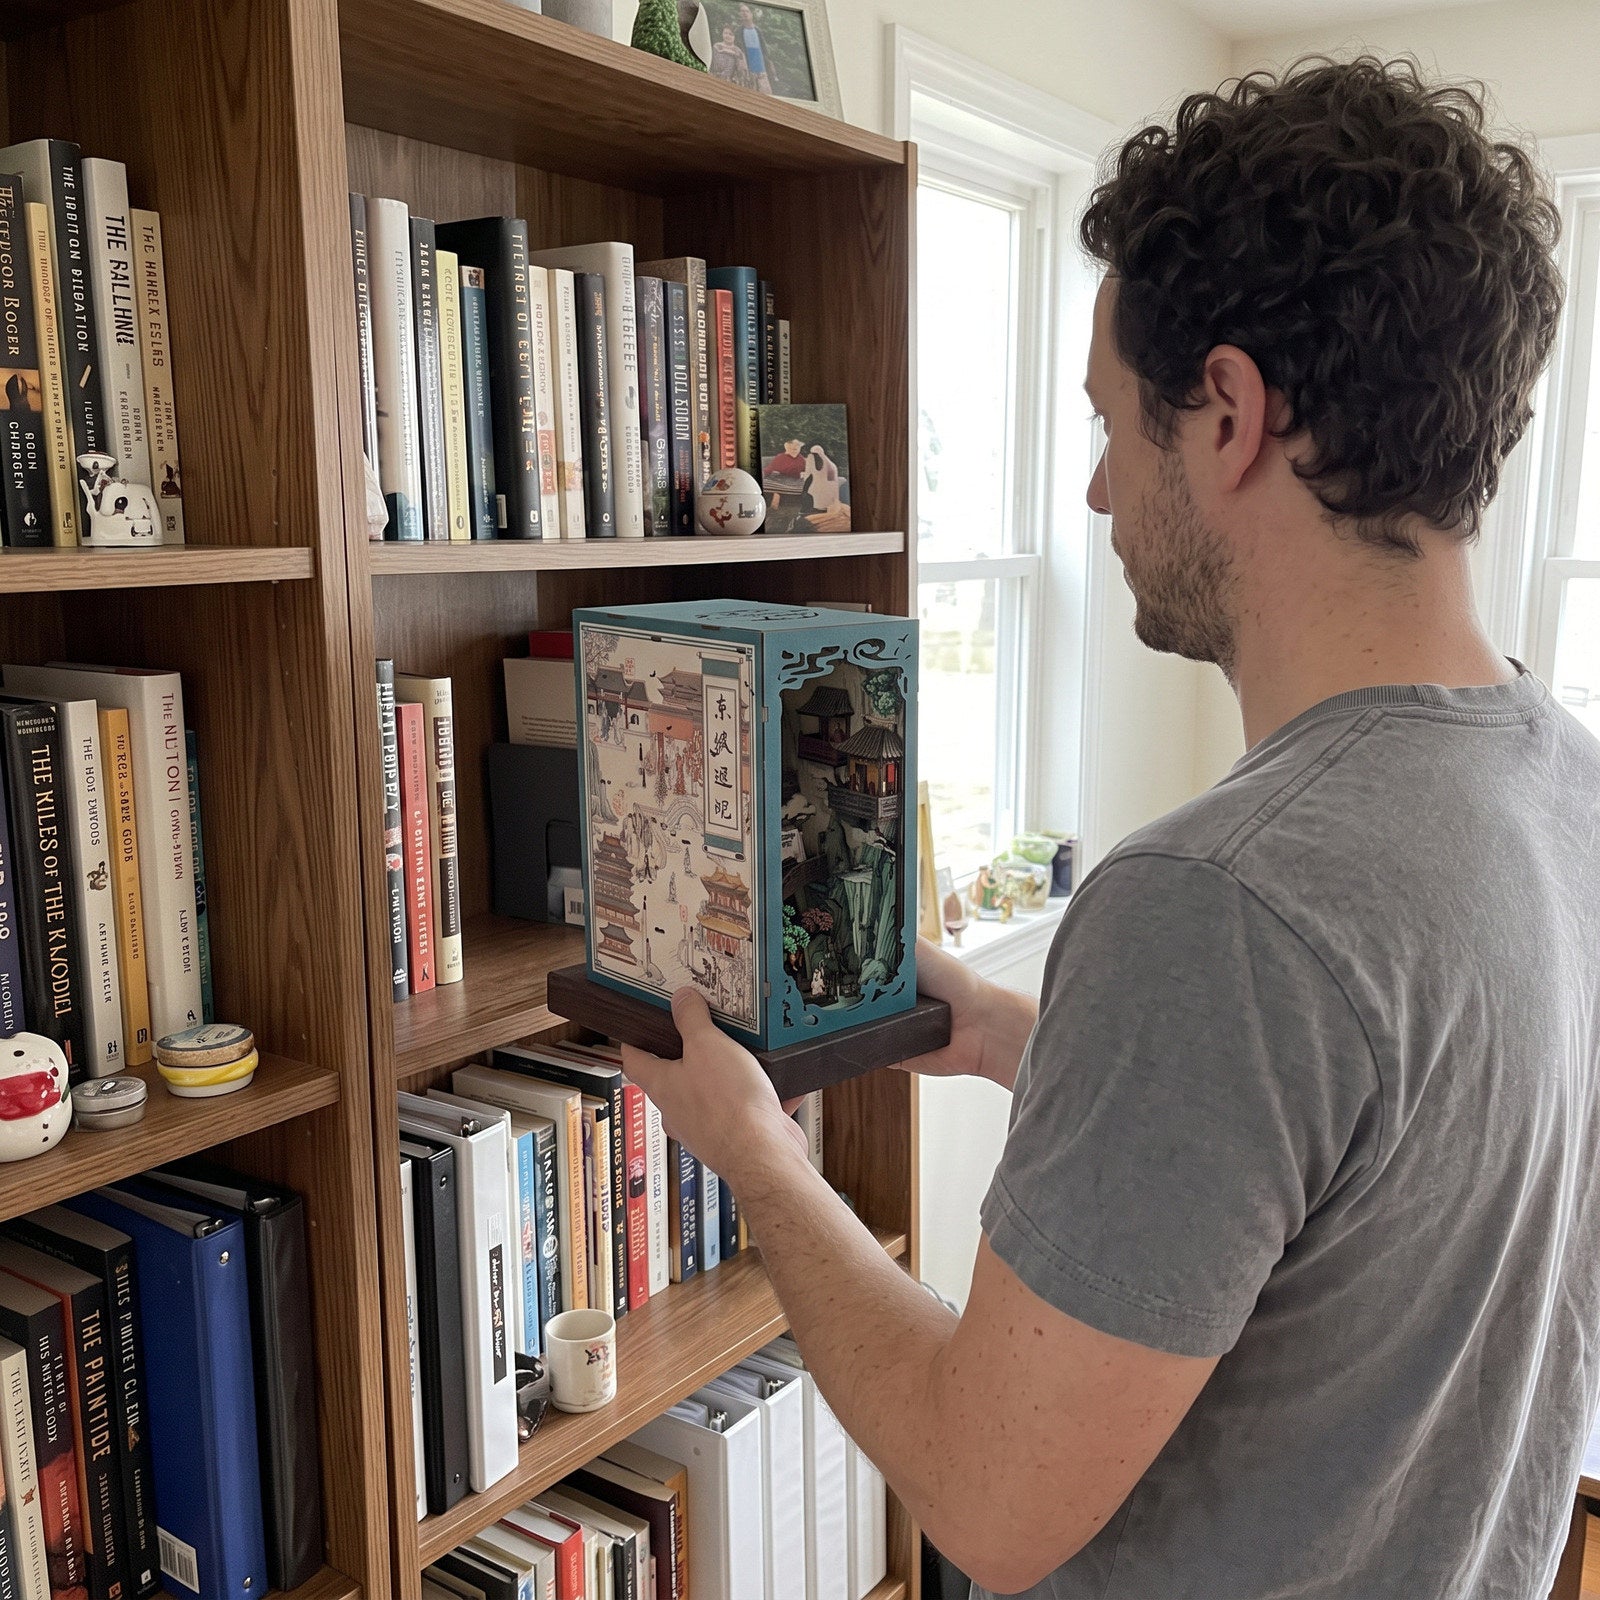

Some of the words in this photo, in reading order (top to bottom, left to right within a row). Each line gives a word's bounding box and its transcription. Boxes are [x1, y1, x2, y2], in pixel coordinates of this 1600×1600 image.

[63, 166, 75, 189] THE
[105, 216, 126, 251] THE
[162, 693, 175, 720] THE
[32, 744, 53, 785] THE
[82, 737, 93, 761] THE
[44, 856, 59, 877] OF
[44, 882, 65, 923] THE
[81, 1310, 103, 1353] THE
[11, 1368, 23, 1397] THE
[84, 1356, 111, 1462] PAINTIDE
